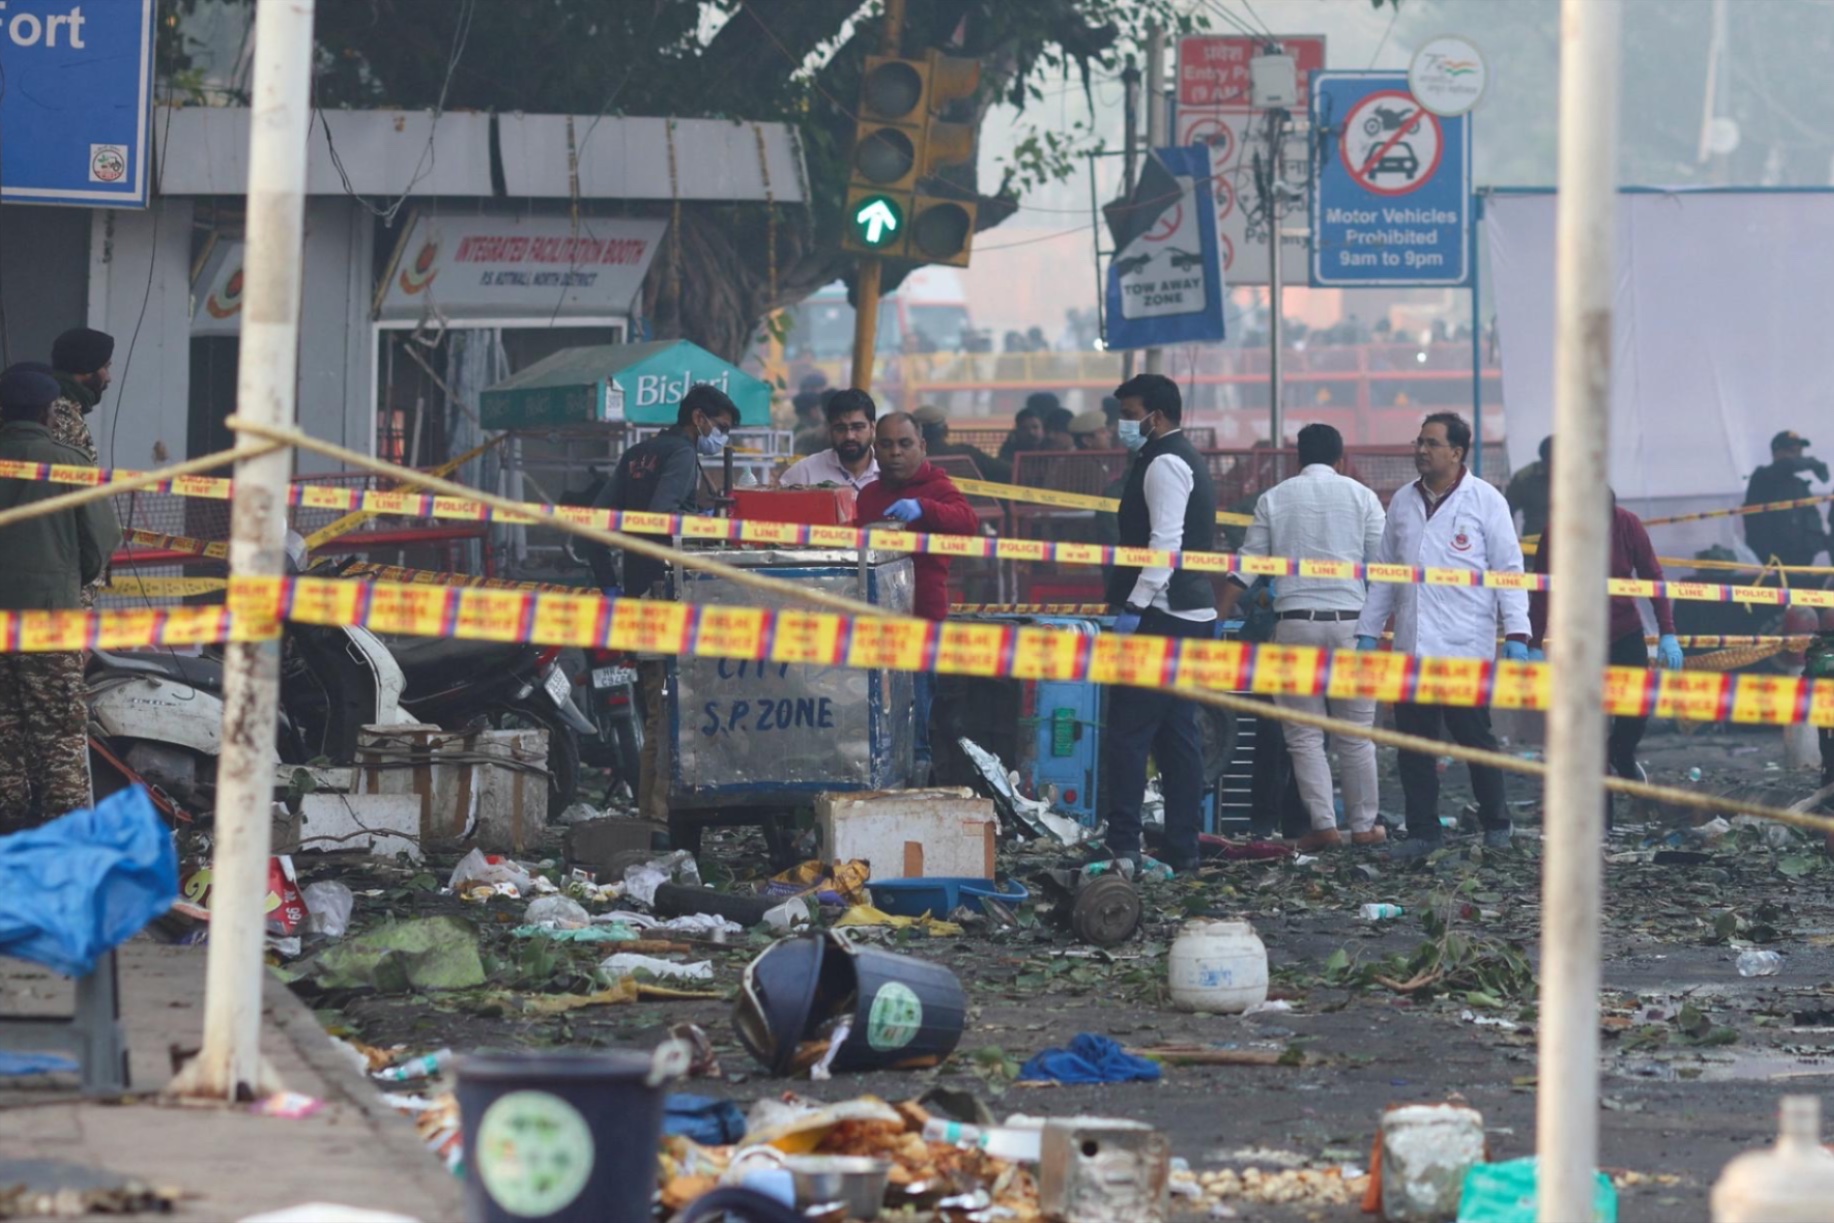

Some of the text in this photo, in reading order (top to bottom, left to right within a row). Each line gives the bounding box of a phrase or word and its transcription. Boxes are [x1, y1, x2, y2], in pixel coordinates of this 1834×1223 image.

[0, 1, 86, 49] ort
[1184, 65, 1229, 84] Entry
[1326, 208, 1458, 224] Motor Vehicles
[1346, 229, 1438, 245] Prohibited
[455, 235, 647, 266] INTEGRATED FACILITATION BOOTH
[1340, 251, 1443, 269] 9am to 9pm
[533, 272, 561, 287] NORTH
[1125, 278, 1200, 295] TOW AWAY
[1144, 292, 1183, 306] ZONE
[52, 469, 95, 484] POLICE
[375, 501, 402, 511] LINE
[435, 501, 477, 513] POLICE
[625, 515, 666, 527] POLICE
[754, 527, 781, 538] LINE
[813, 530, 854, 541] POLICE
[941, 542, 967, 552] LINE
[1001, 542, 1041, 553] POLICE
[1127, 554, 1153, 564] LINE
[1185, 555, 1226, 566] POLICE
[1312, 566, 1338, 576] LINE
[1370, 566, 1410, 578] POLICE
[1495, 577, 1521, 586] LINE
[1678, 588, 1704, 597] LINE
[1735, 588, 1775, 599] POLICE
[756, 697, 835, 731] ZONE
